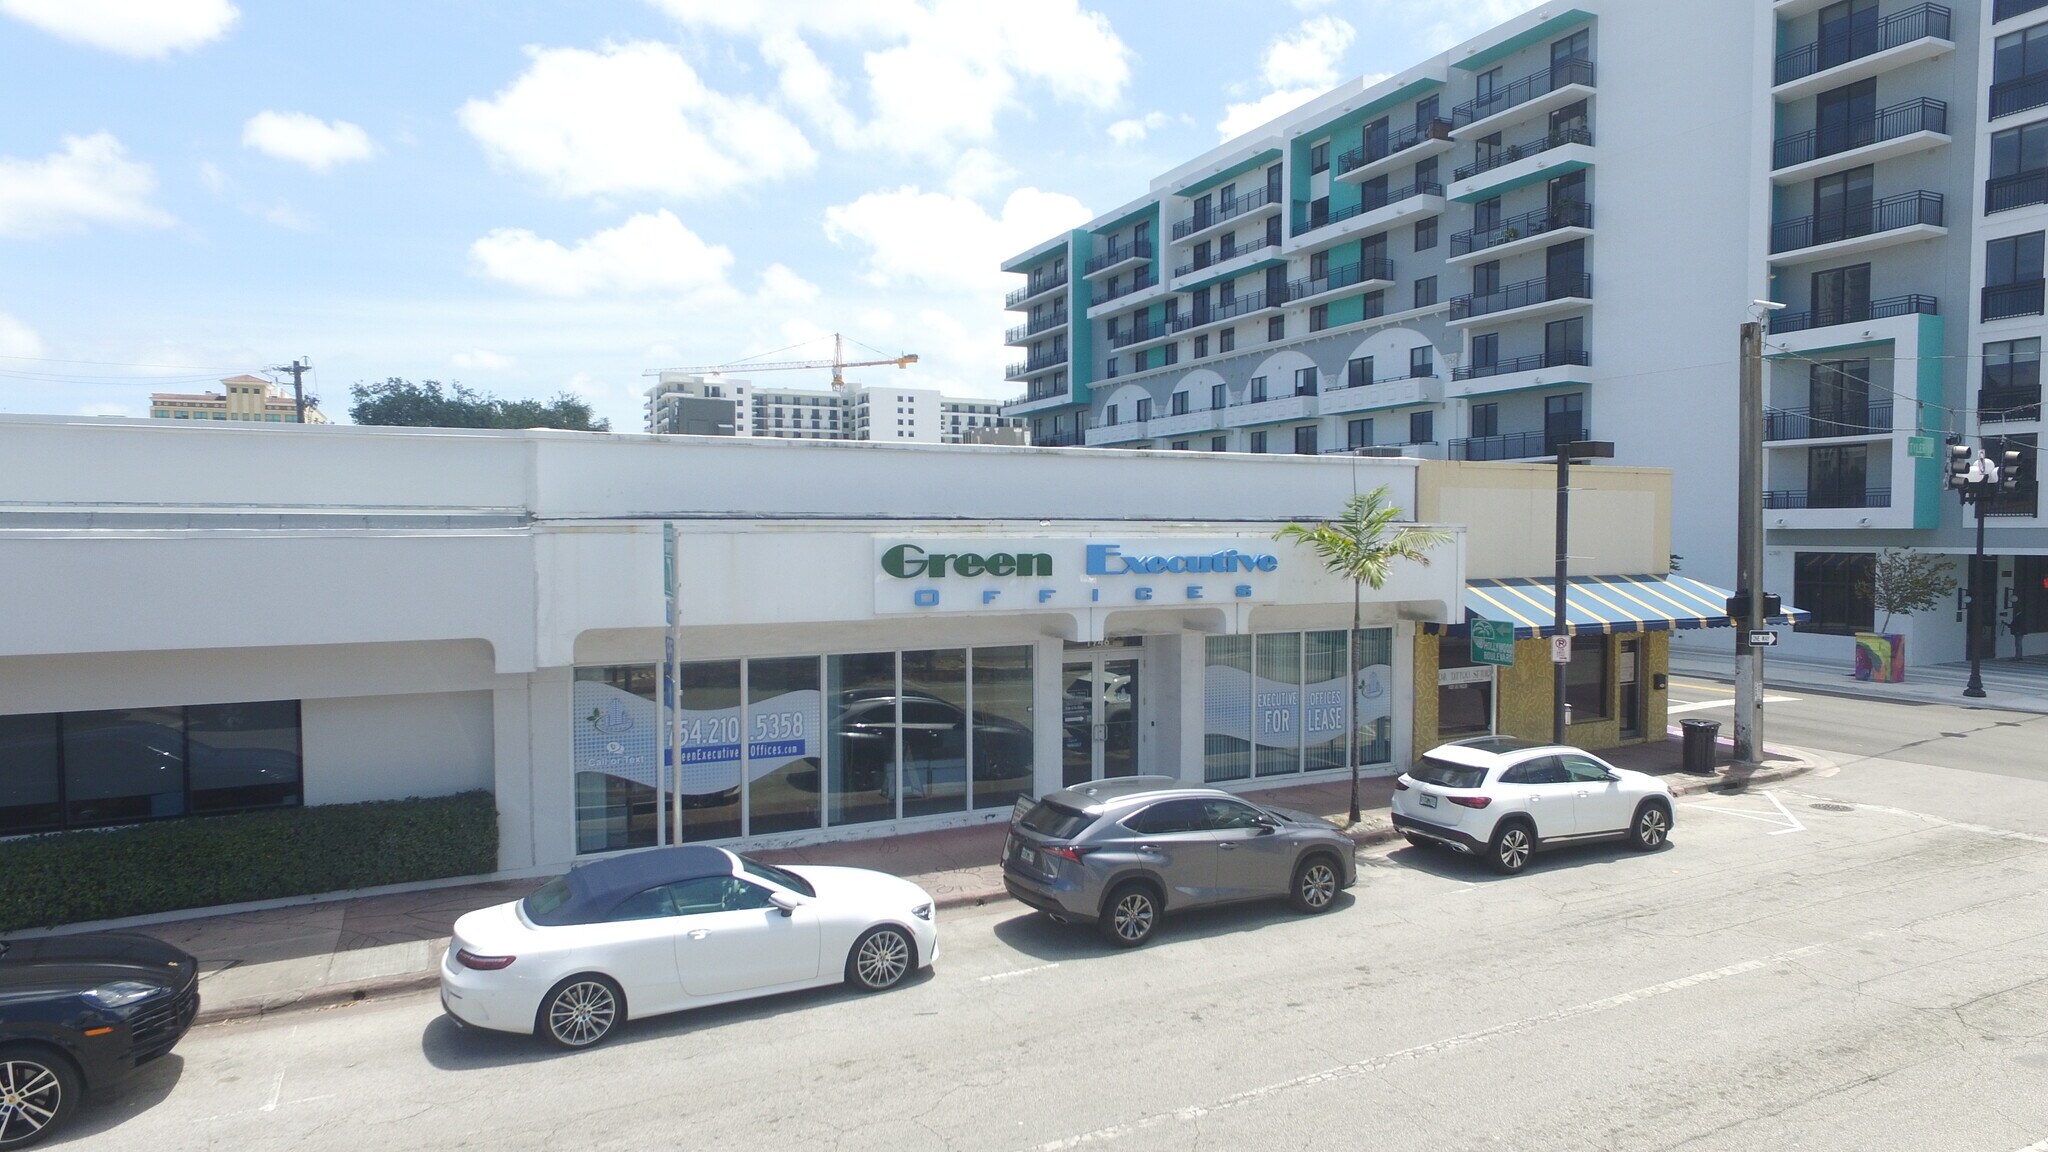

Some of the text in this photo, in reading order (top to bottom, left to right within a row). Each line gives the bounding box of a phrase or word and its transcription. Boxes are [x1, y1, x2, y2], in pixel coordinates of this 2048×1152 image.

[881, 544, 1279, 579] Green Executive
[914, 584, 1252, 607] OFFICES
[1257, 691, 1341, 707] EXECUTIVE OFFICES
[1264, 707, 1342, 733] FOR LEASE
[588, 758, 608, 767] Call
[624, 755, 644, 764] Text
